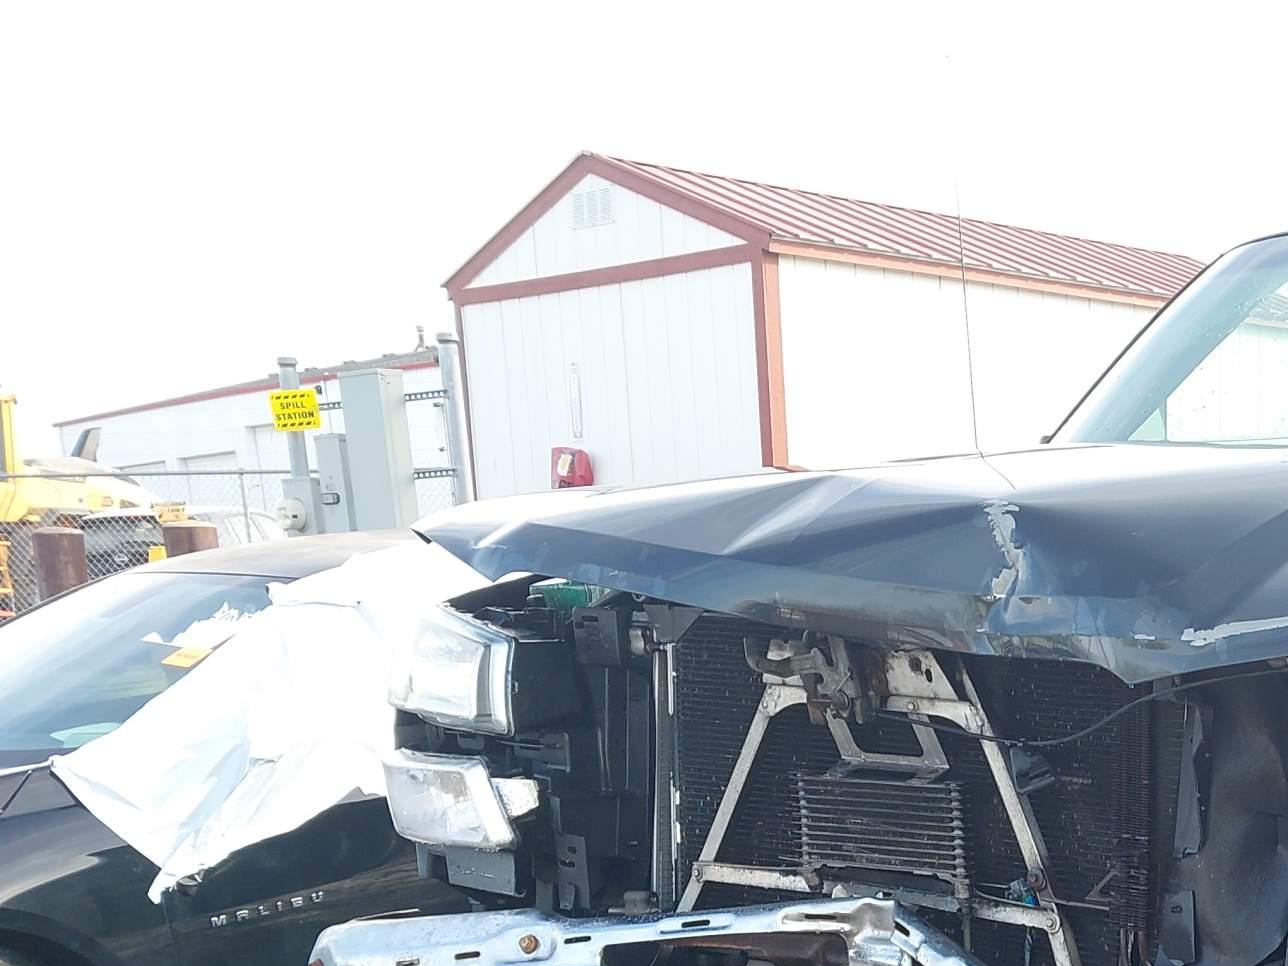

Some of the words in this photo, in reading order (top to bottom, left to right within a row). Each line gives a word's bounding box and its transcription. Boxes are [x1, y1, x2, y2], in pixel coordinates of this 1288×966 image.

[280, 401, 306, 409] SPILL
[275, 411, 314, 420] STATION
[210, 891, 323, 927] MALIBU
